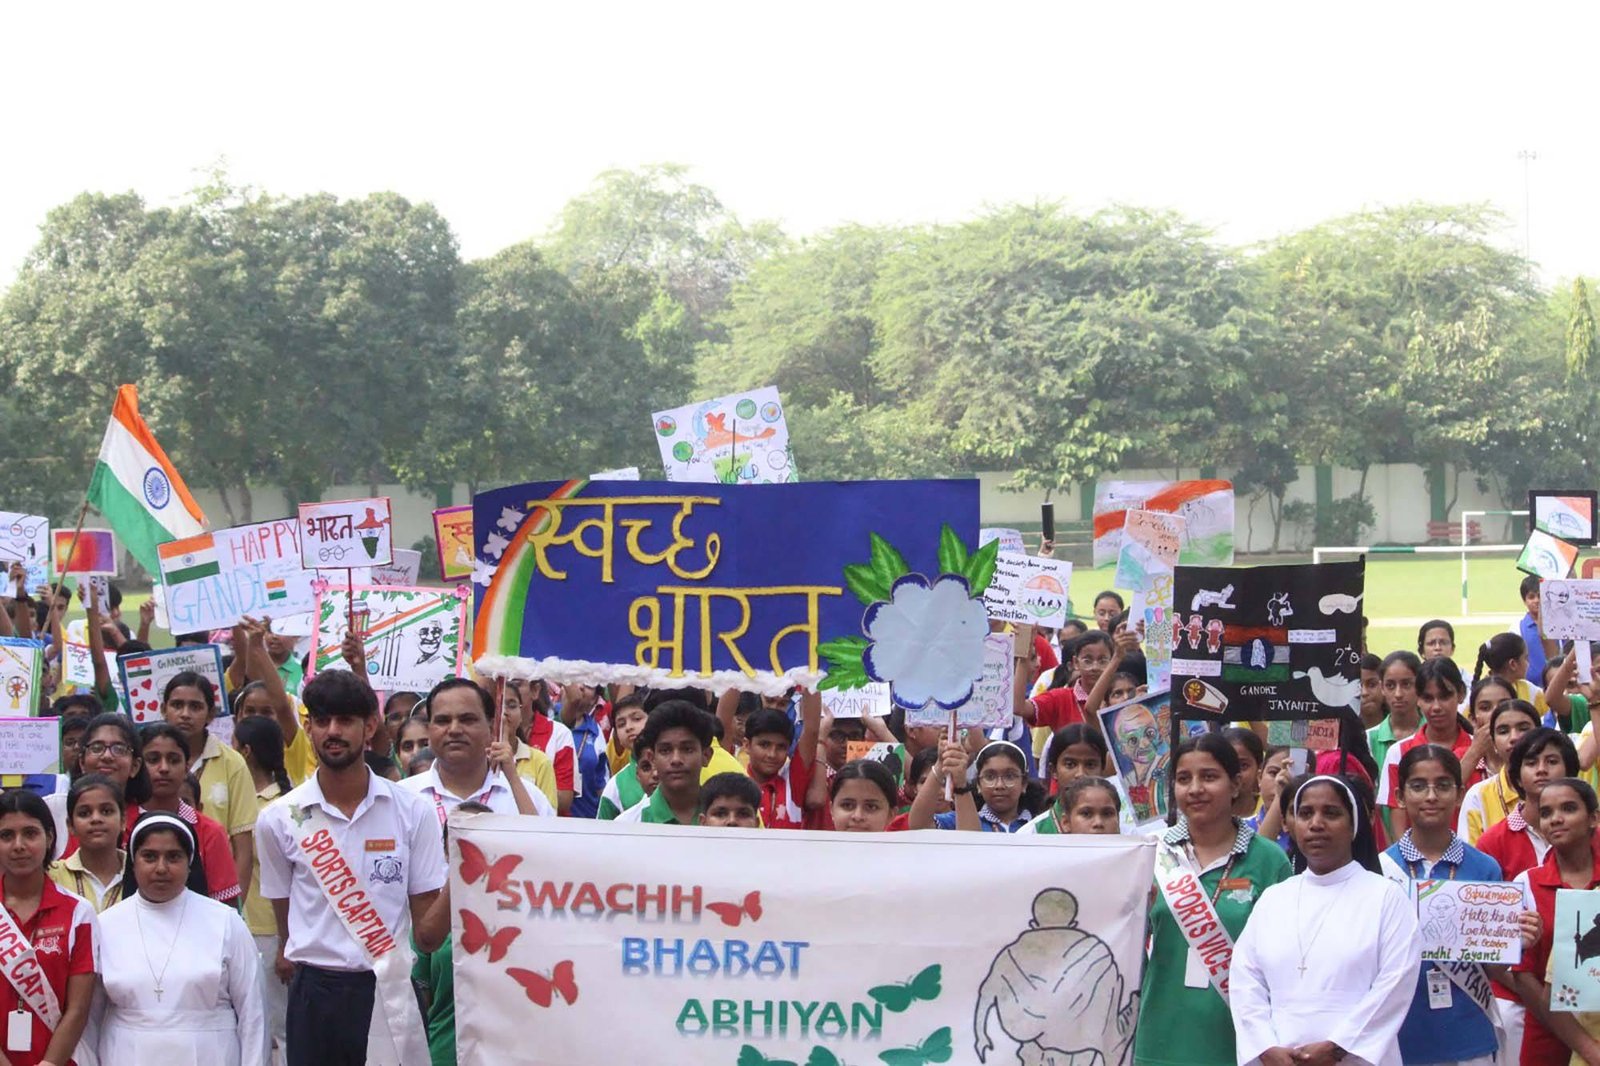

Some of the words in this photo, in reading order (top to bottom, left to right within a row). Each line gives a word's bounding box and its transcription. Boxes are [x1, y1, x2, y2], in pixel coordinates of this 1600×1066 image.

[230, 520, 299, 565] HAPPY
[306, 514, 353, 544] भारत
[526, 495, 720, 583] स्वच्छ
[986, 606, 1028, 620] Sanitation
[628, 585, 843, 678] भारत
[1268, 699, 1319, 713] JAYANTI
[301, 829, 357, 896] SPORTS
[337, 890, 397, 958] CAPTAIN
[497, 879, 703, 914] SWACHH
[1166, 874, 1218, 939] SPORTS
[1197, 932, 1233, 976] VICE
[1460, 907, 1488, 923] Hate
[1460, 923, 1479, 936] Love
[621, 937, 810, 968] BHARAT
[1421, 946, 1452, 959] andhi
[1456, 948, 1501, 961] Jayanti
[675, 998, 884, 1029] ABHIYAN
